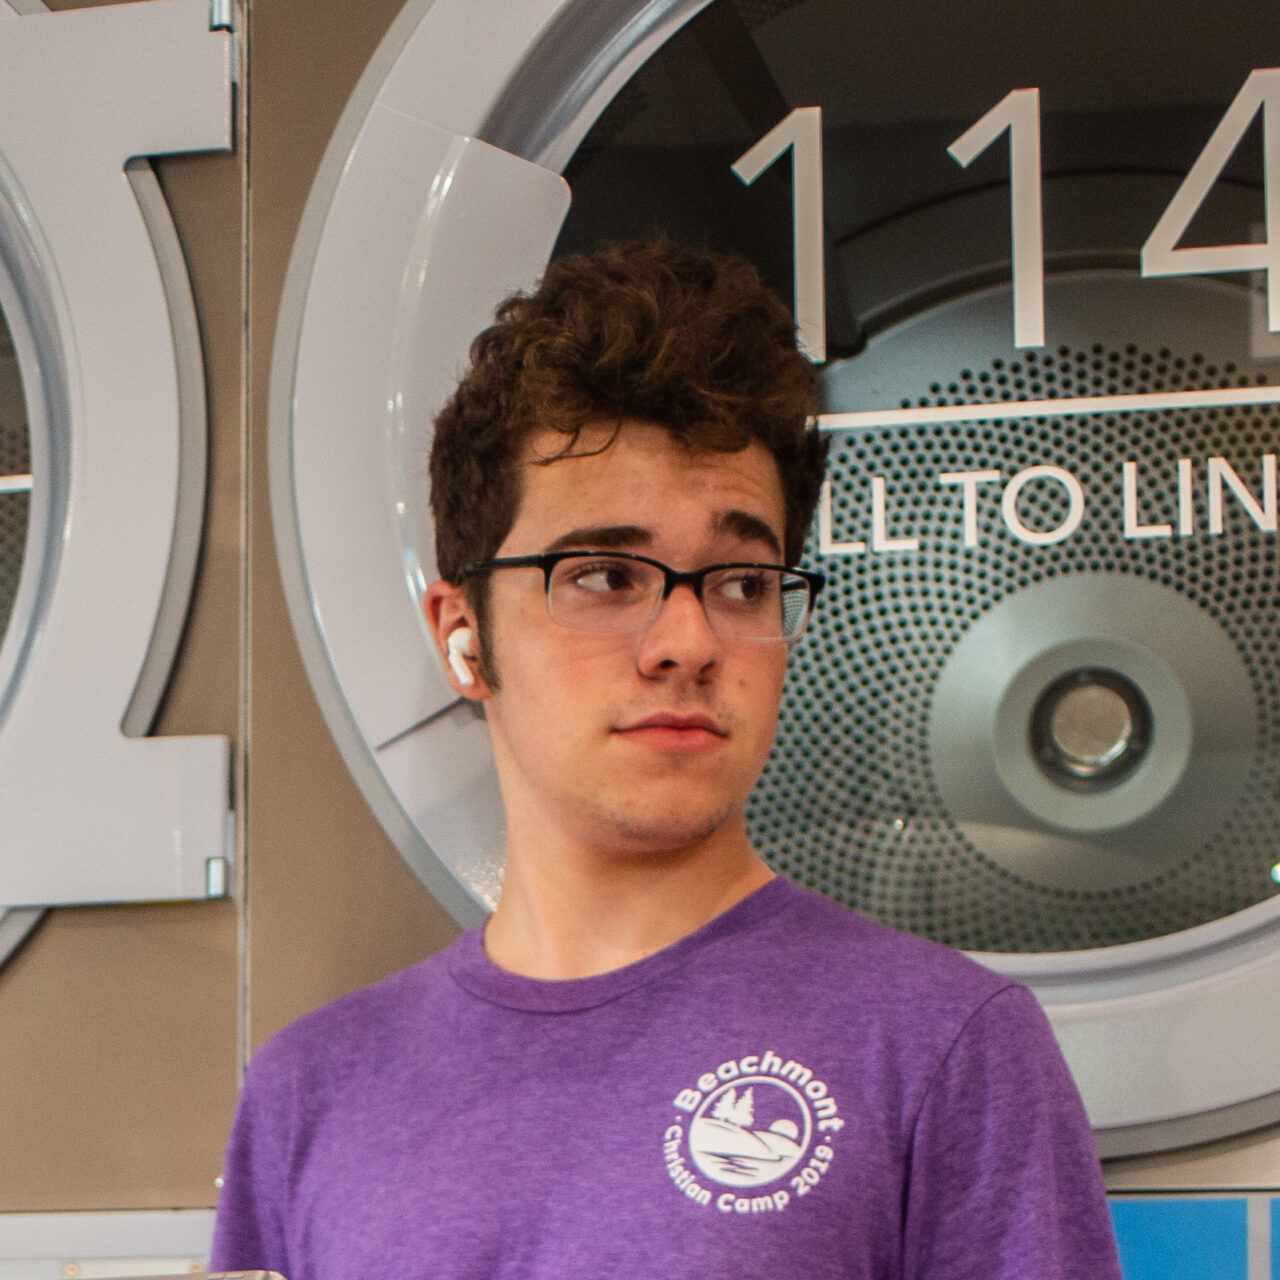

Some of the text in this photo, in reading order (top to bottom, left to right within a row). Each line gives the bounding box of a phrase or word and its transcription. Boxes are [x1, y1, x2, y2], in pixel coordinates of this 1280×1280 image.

[730, 68, 1280, 363] 114
[819, 453, 1280, 554] LL TO LIN
[673, 1050, 845, 1132] Beachmont
[664, 1125, 834, 1213] Christian Camp 2019
